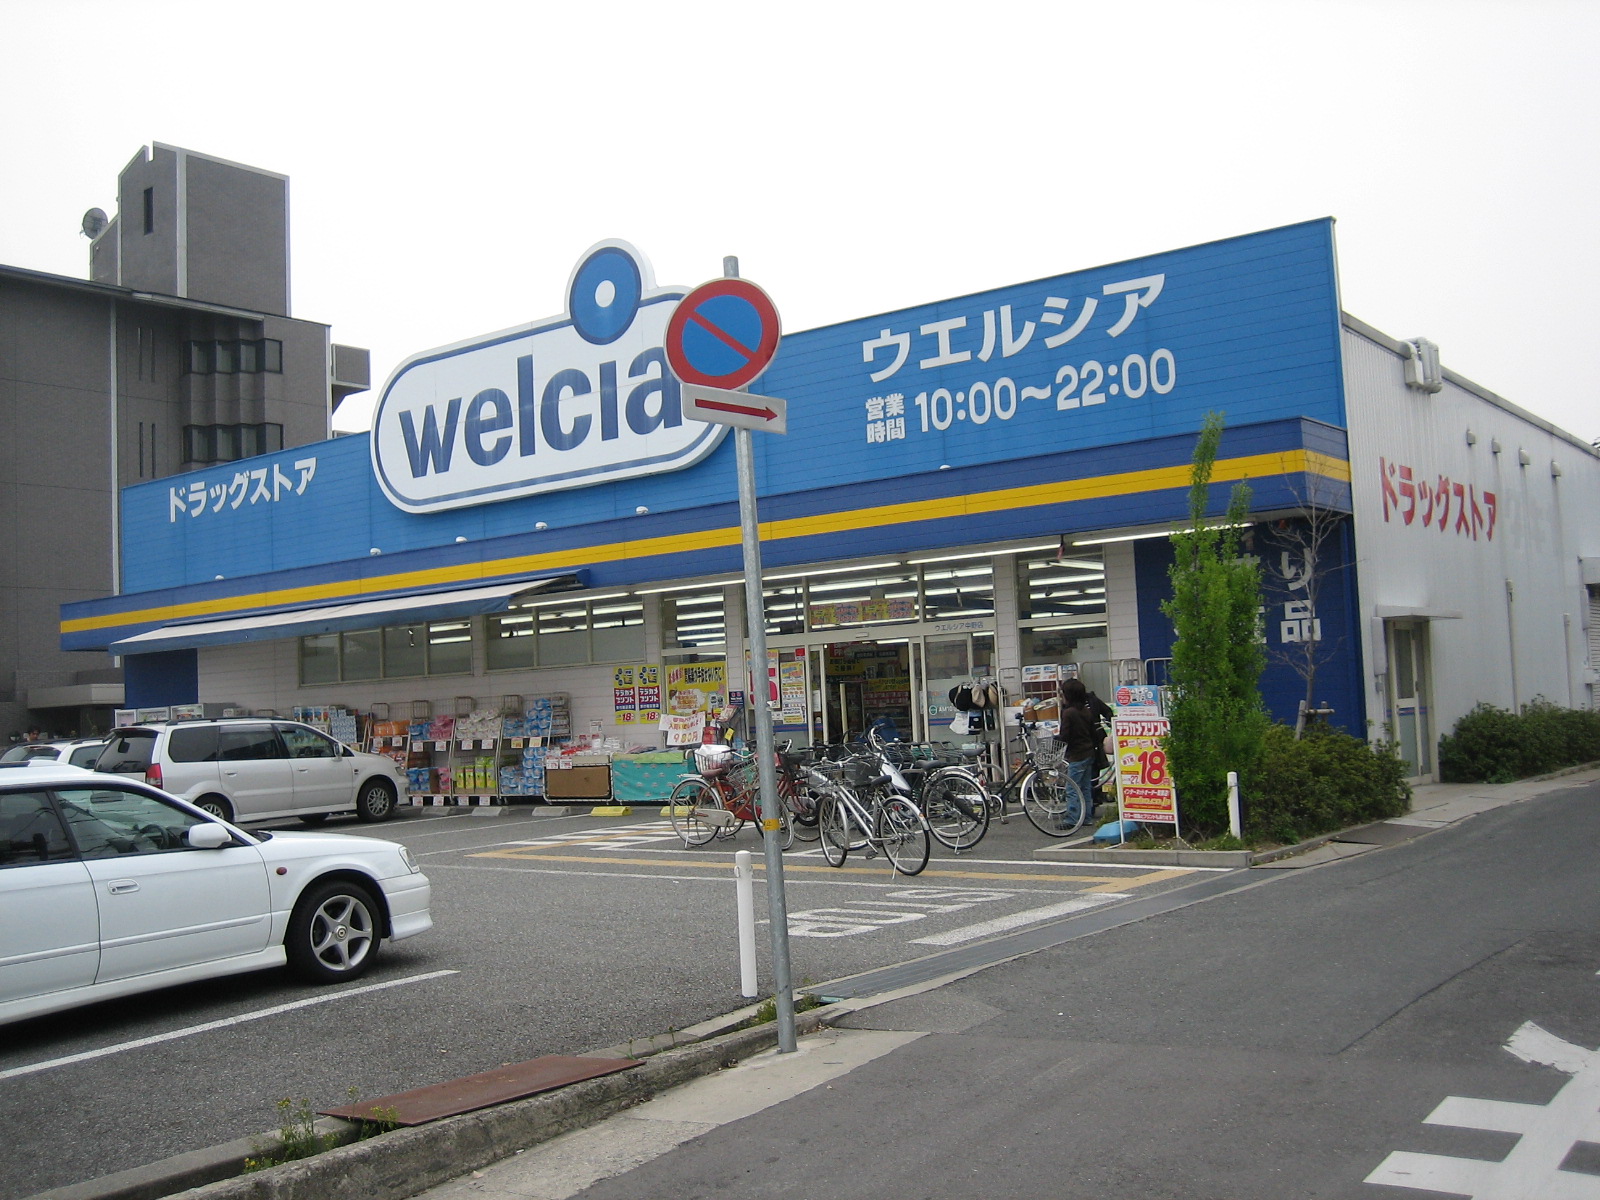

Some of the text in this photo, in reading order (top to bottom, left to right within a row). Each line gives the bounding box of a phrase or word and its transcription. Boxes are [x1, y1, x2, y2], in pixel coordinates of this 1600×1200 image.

[862, 273, 1165, 383] ウエルシア
[399, 346, 684, 479] welcia
[865, 393, 905, 421] 営業
[866, 419, 906, 443] 時間
[169, 457, 317, 523] ドラッグストア
[1379, 456, 1497, 542] ドラッグストア
[1137, 750, 1166, 785] 18
